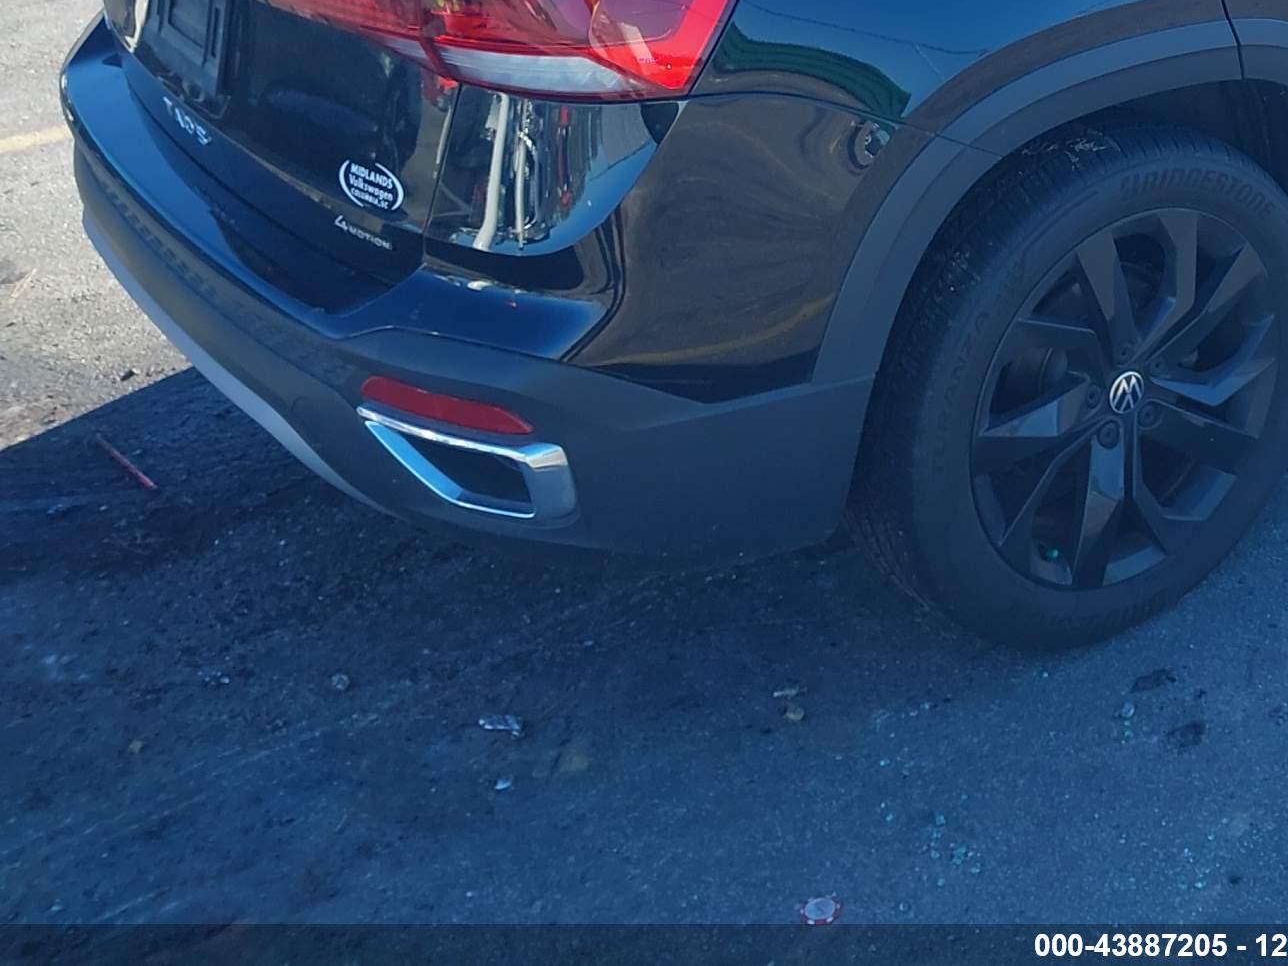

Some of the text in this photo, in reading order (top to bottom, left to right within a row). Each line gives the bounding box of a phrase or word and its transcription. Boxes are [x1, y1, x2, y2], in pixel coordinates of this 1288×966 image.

[349, 174, 394, 202] Volkswagen
[350, 163, 394, 190] MIDLANDS
[1120, 168, 1275, 219] BRIDGESTONE
